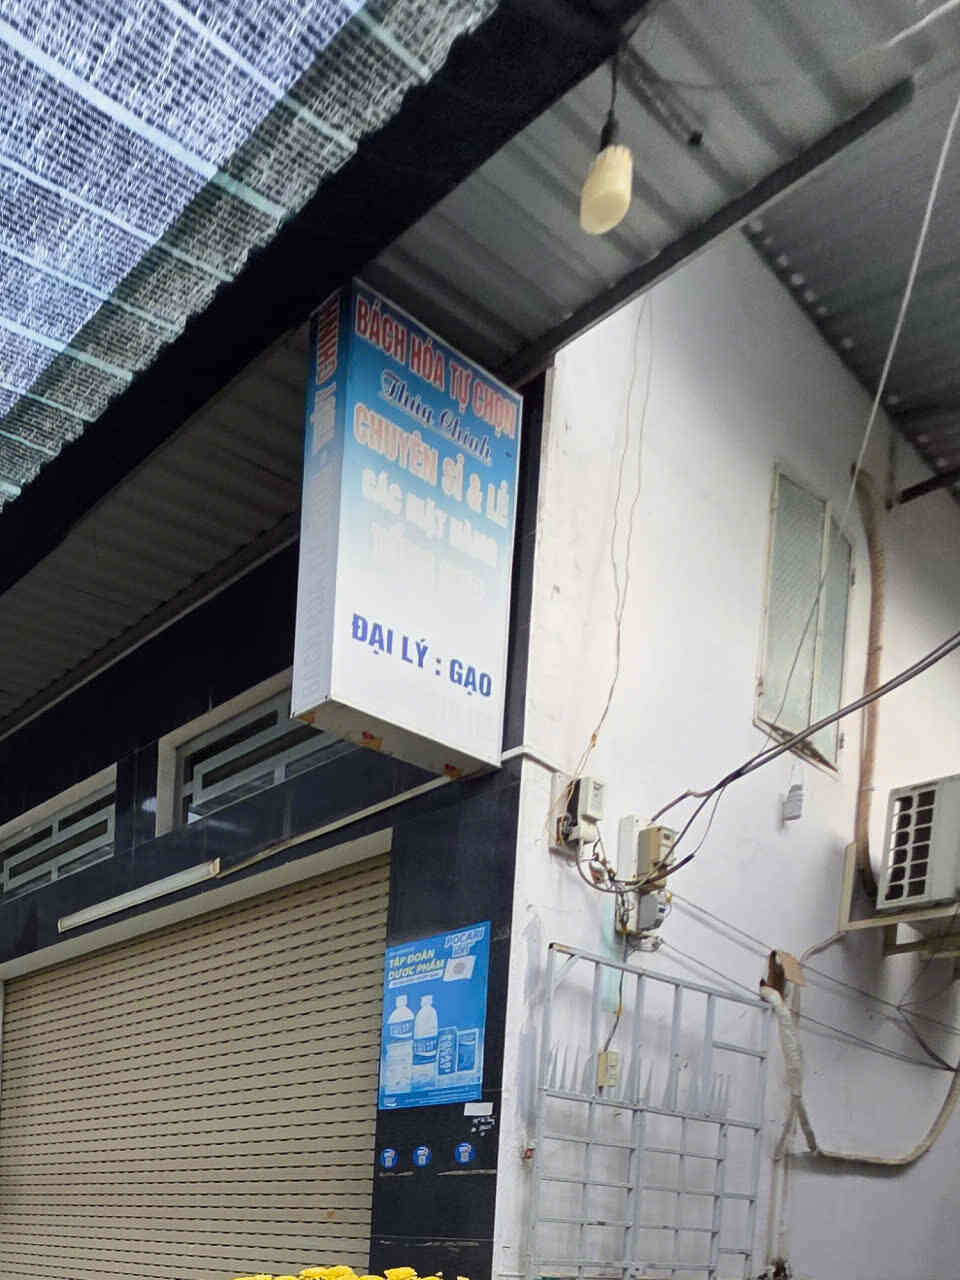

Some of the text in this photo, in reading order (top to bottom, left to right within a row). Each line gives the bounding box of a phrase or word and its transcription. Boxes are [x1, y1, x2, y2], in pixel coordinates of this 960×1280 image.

[356, 294, 516, 439] BÁCH HÓA TỰ CHỌN
[353, 403, 438, 486] CHUYÊN
[351, 612, 394, 655] ĐẠI
[401, 637, 429, 669] LÝ
[449, 658, 493, 697] GẠO
